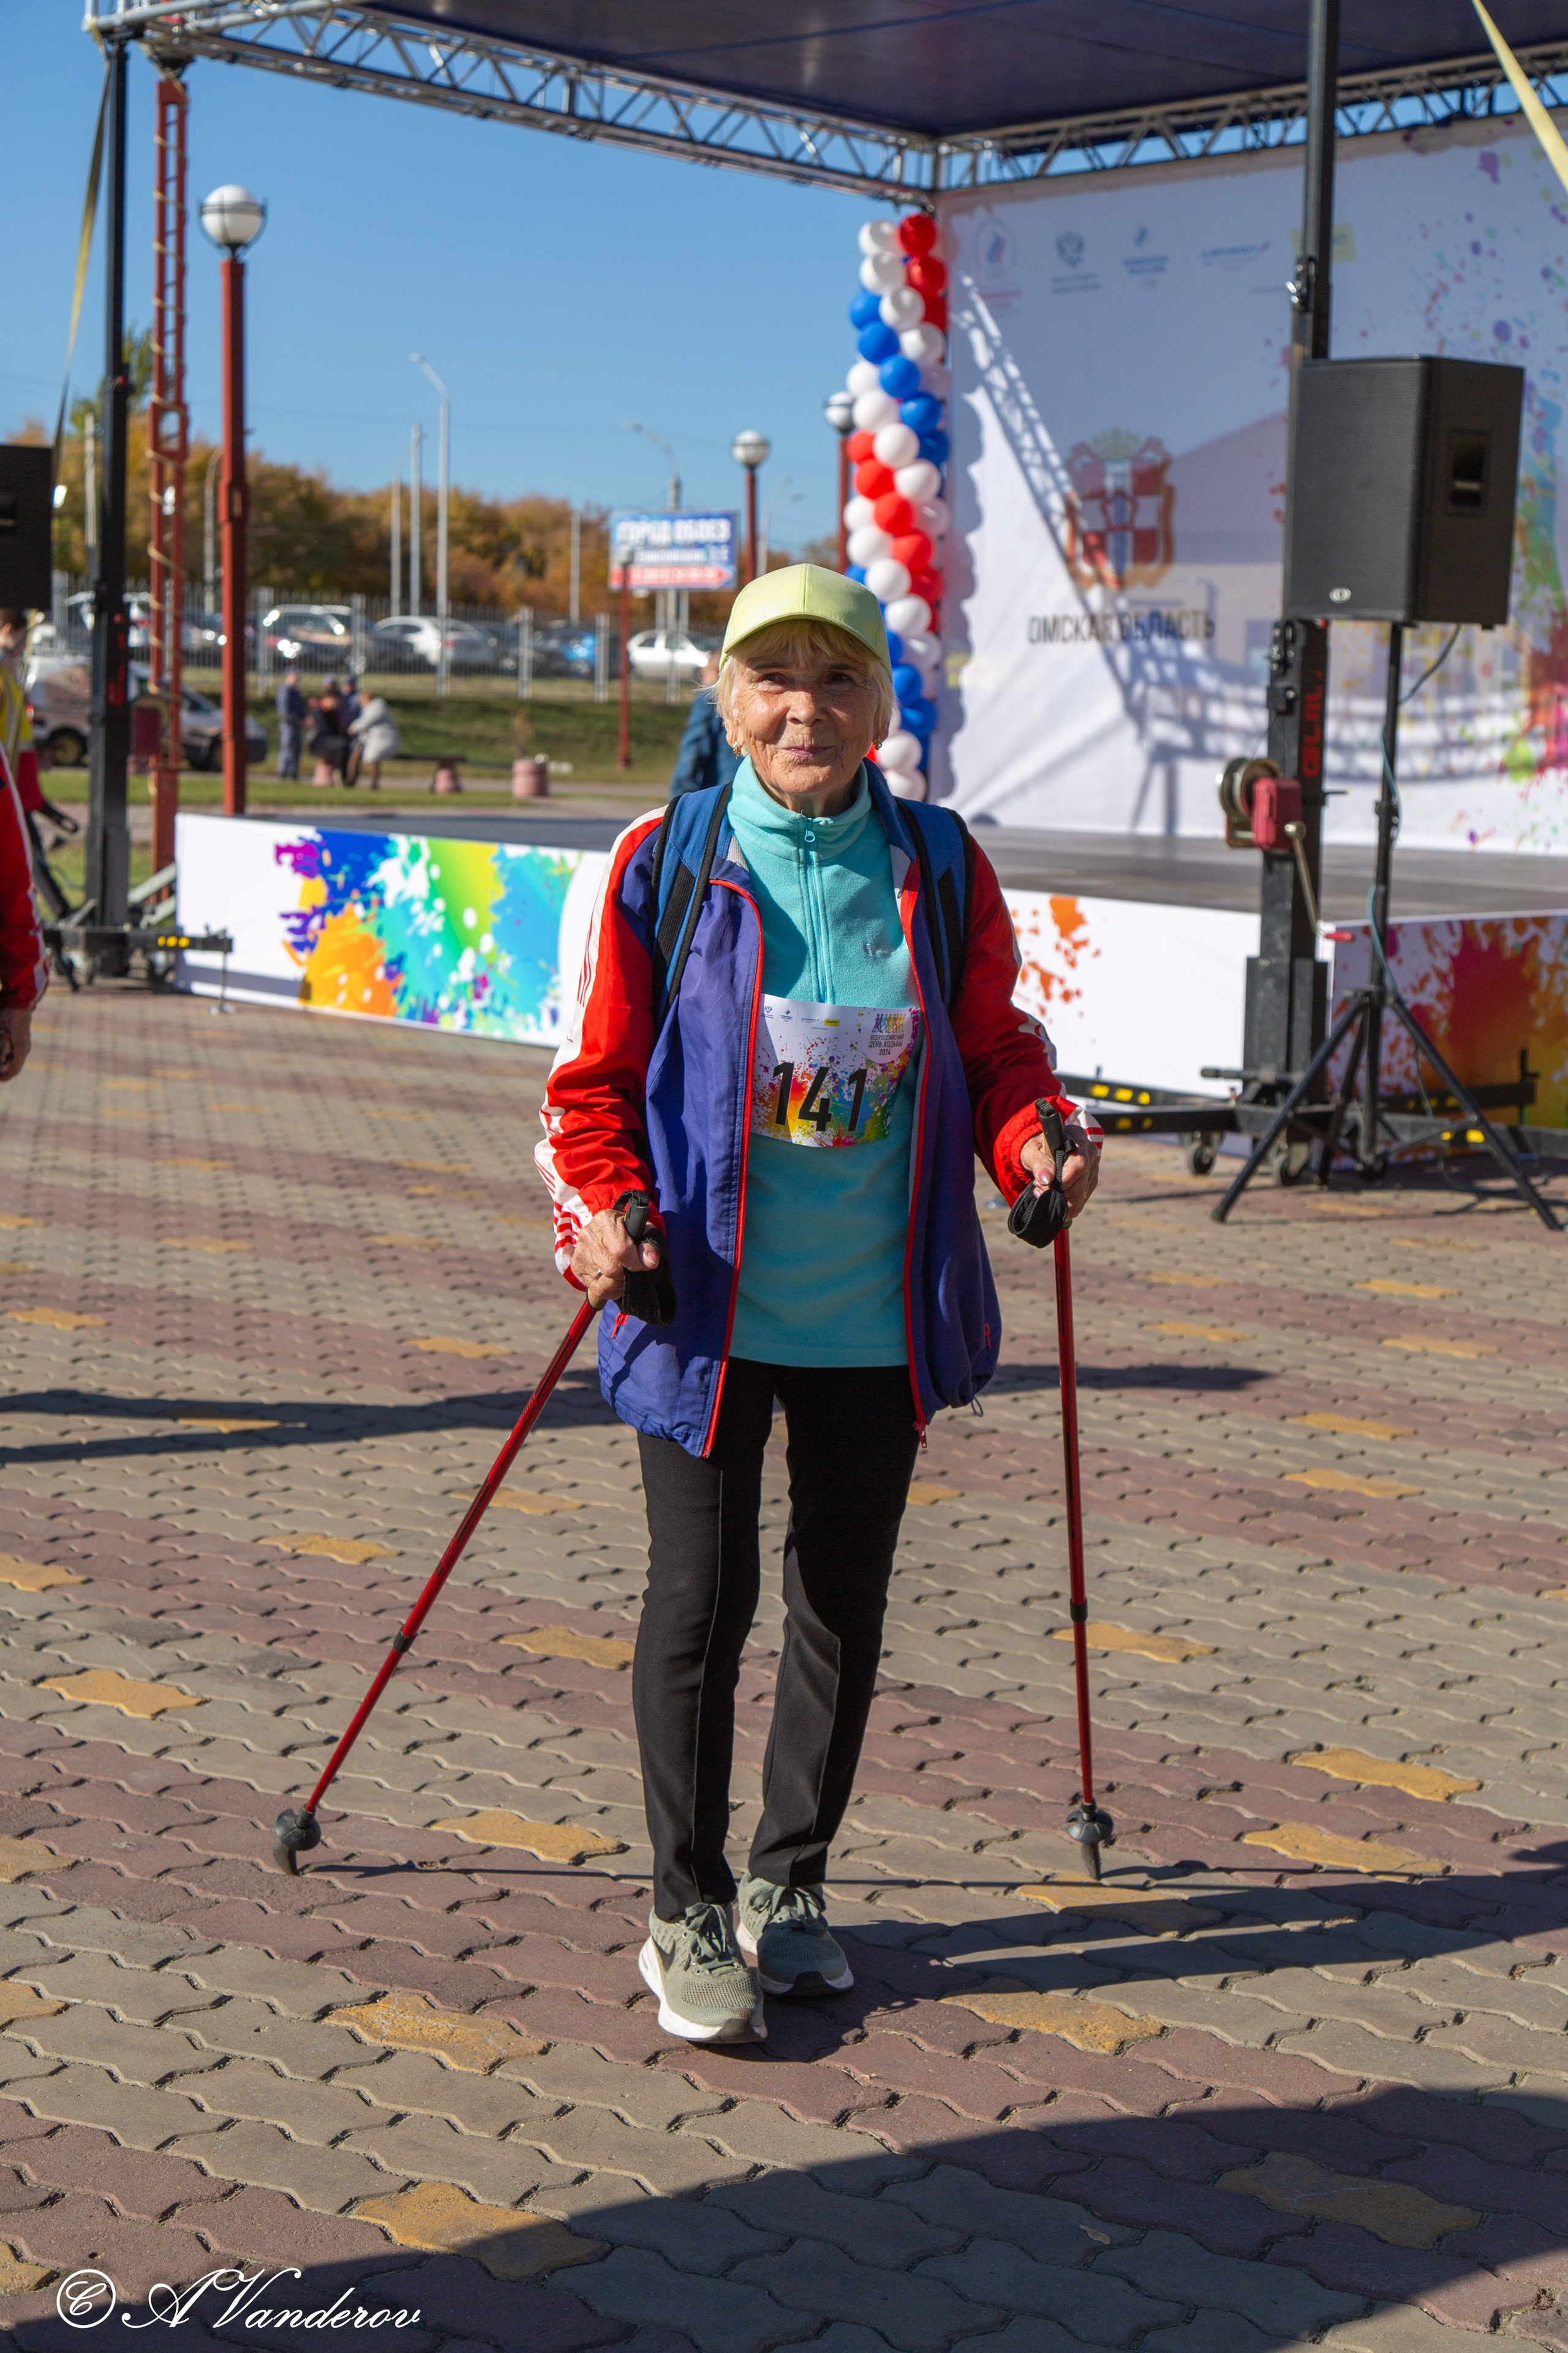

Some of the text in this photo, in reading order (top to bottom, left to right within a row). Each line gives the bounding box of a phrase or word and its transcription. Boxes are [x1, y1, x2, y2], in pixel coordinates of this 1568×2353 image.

[1030, 610, 1216, 643] ОМСКАЯ ОБЛАСТЬ
[772, 1062, 868, 1132] 141
